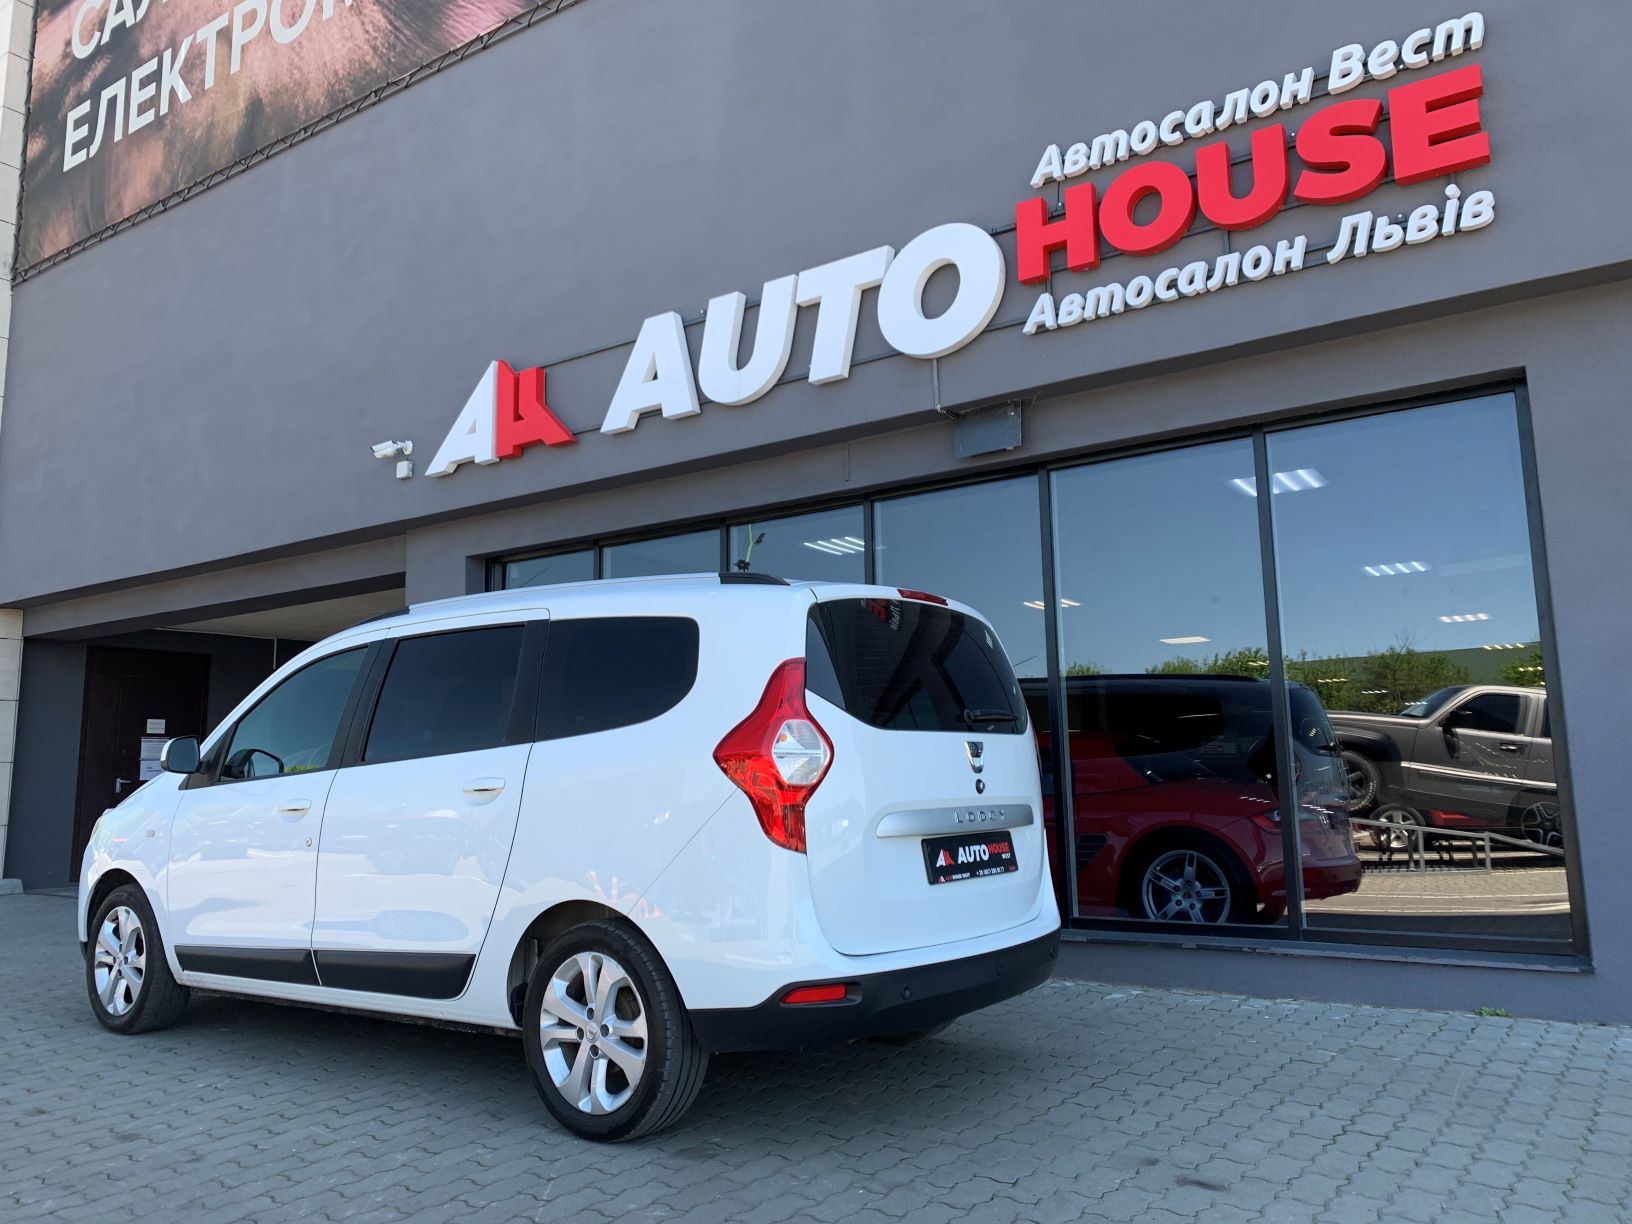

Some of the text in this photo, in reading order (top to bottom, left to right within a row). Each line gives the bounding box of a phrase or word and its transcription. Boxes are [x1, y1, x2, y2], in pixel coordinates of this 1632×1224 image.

[62, 0, 352, 172] ЕЛЕКТРО
[1030, 11, 1486, 188] Автосалон Вест
[601, 222, 1006, 435] AUTO
[1015, 64, 1491, 286] HOUSE
[1022, 183, 1496, 335] Автосалон Львів
[957, 843, 990, 864] AUTO
[988, 841, 1010, 855] HOUSE
